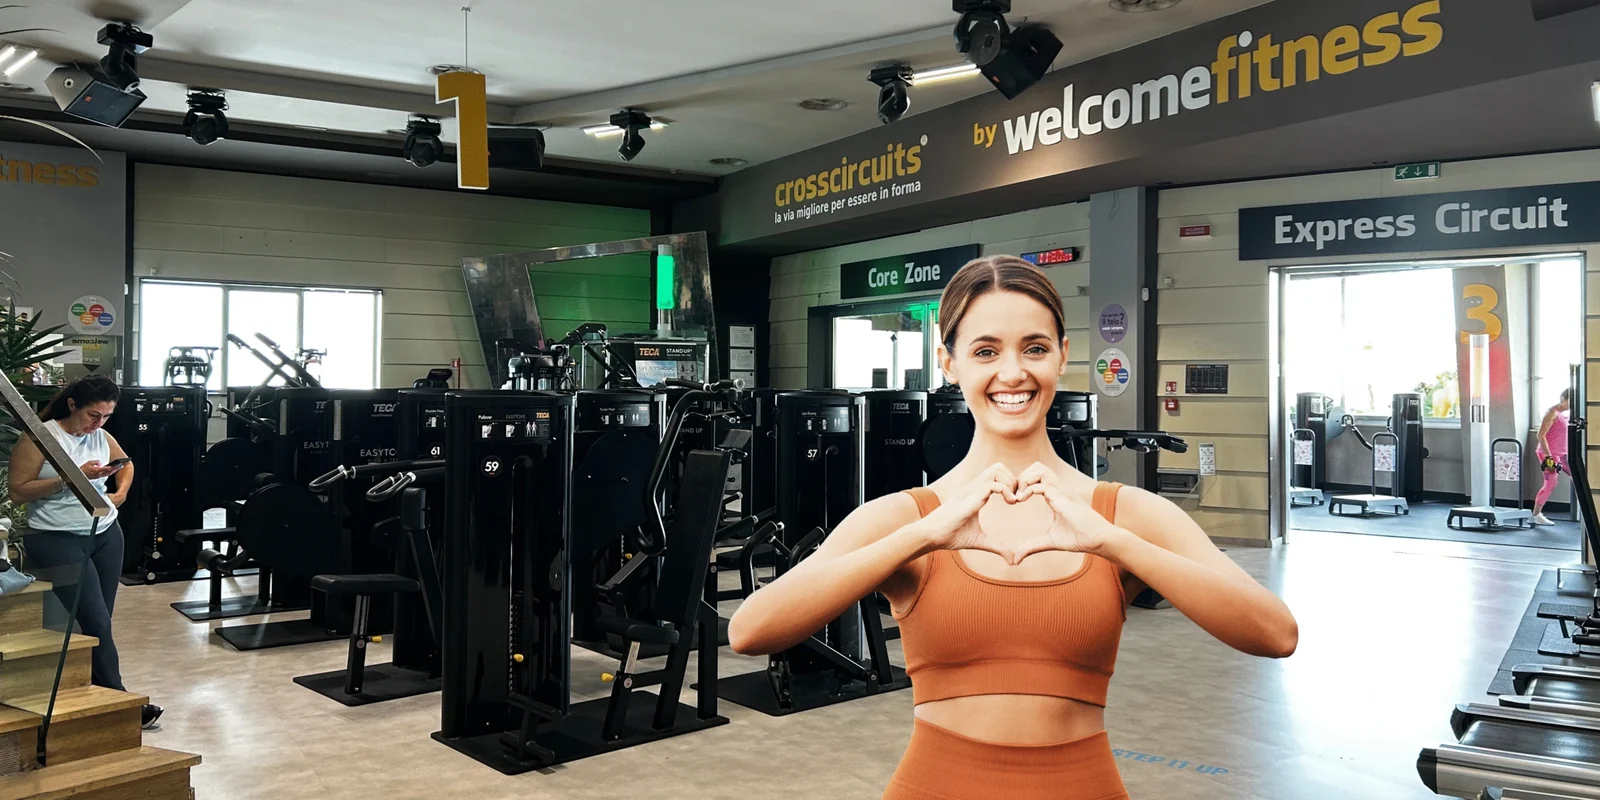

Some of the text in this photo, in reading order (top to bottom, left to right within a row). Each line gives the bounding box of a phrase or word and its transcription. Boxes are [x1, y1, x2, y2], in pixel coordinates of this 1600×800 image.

[434, 70, 490, 190] 1
[973, 121, 998, 148] by
[774, 180, 922, 224] la via migliore per essere in forma
[1275, 197, 1568, 250] Express Circuit
[868, 262, 941, 288] Core Zone
[1460, 283, 1502, 345] 3
[639, 347, 660, 357] TECA
[138, 423, 148, 431] 55
[430, 446, 441, 455] 61
[807, 450, 818, 458] 57
[907, 438, 916, 446] UP
[484, 461, 499, 472] 59
[1111, 748, 1229, 775] STEP IT UP
